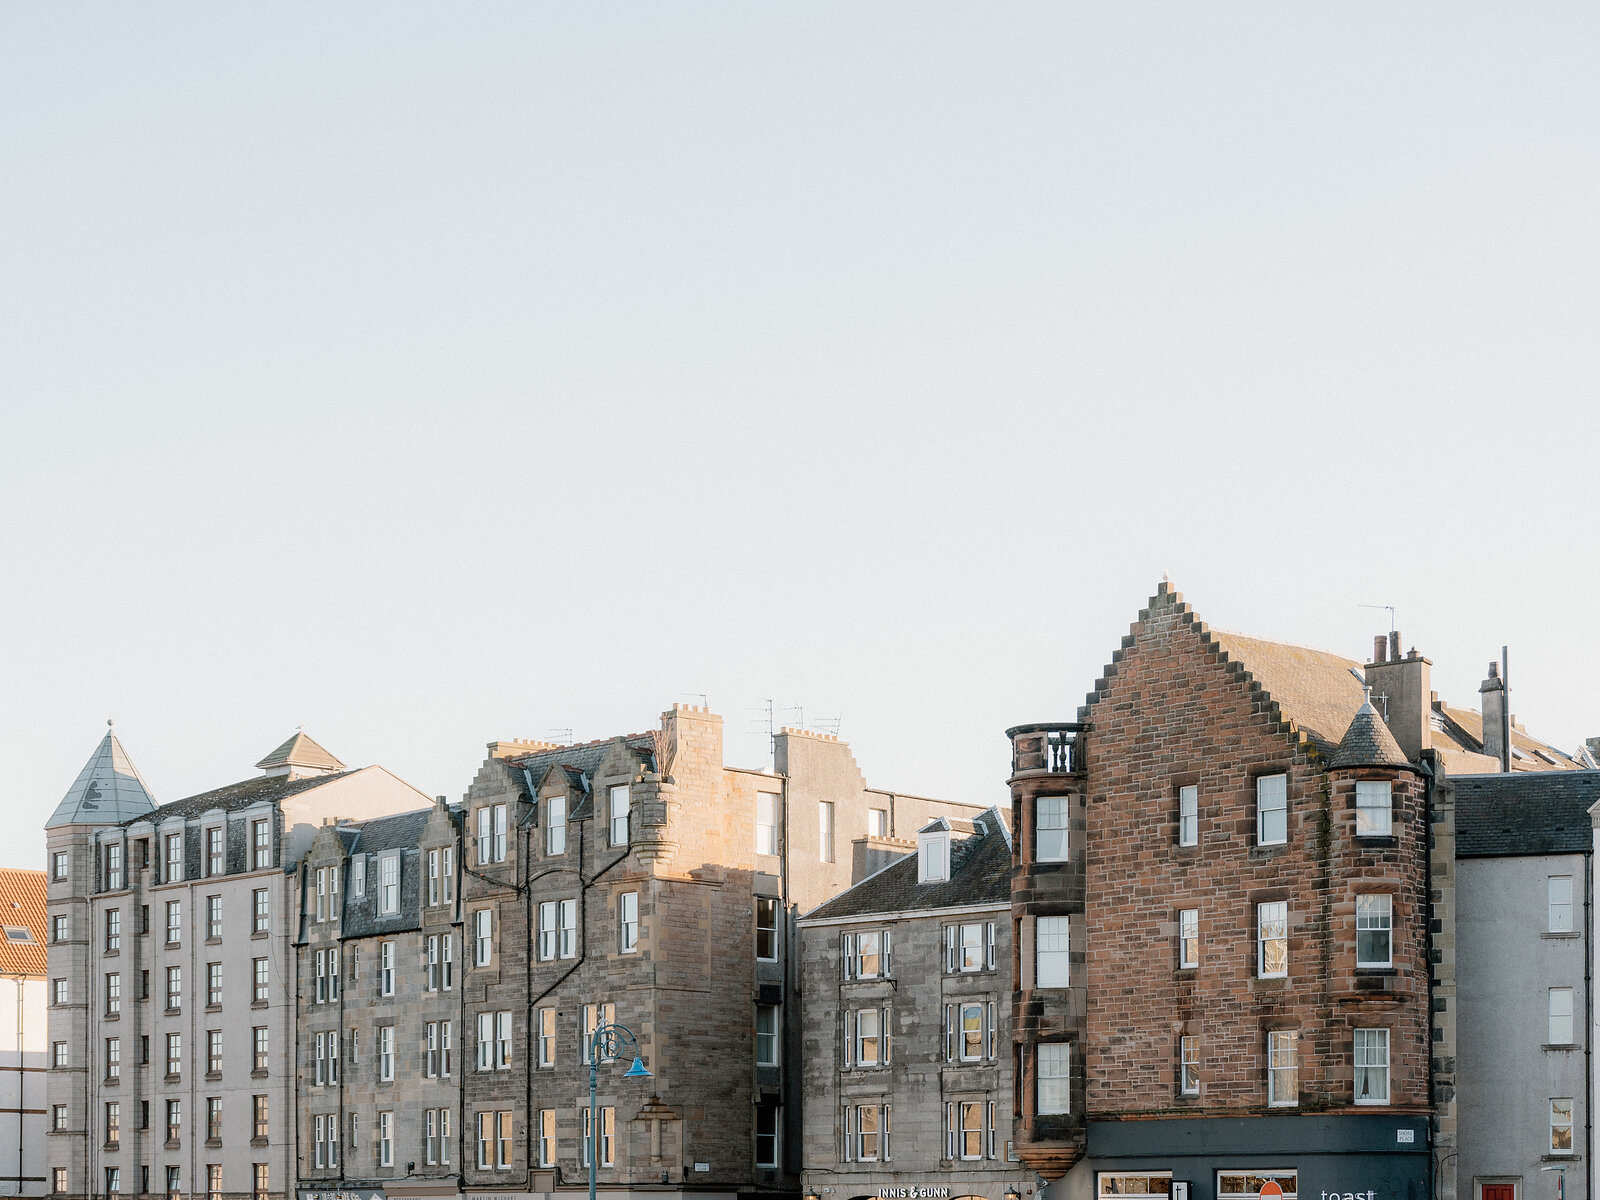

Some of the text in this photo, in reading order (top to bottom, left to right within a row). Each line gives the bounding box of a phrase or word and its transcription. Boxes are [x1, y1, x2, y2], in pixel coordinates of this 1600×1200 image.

[879, 1186, 949, 1199] INNIS & GUNN
